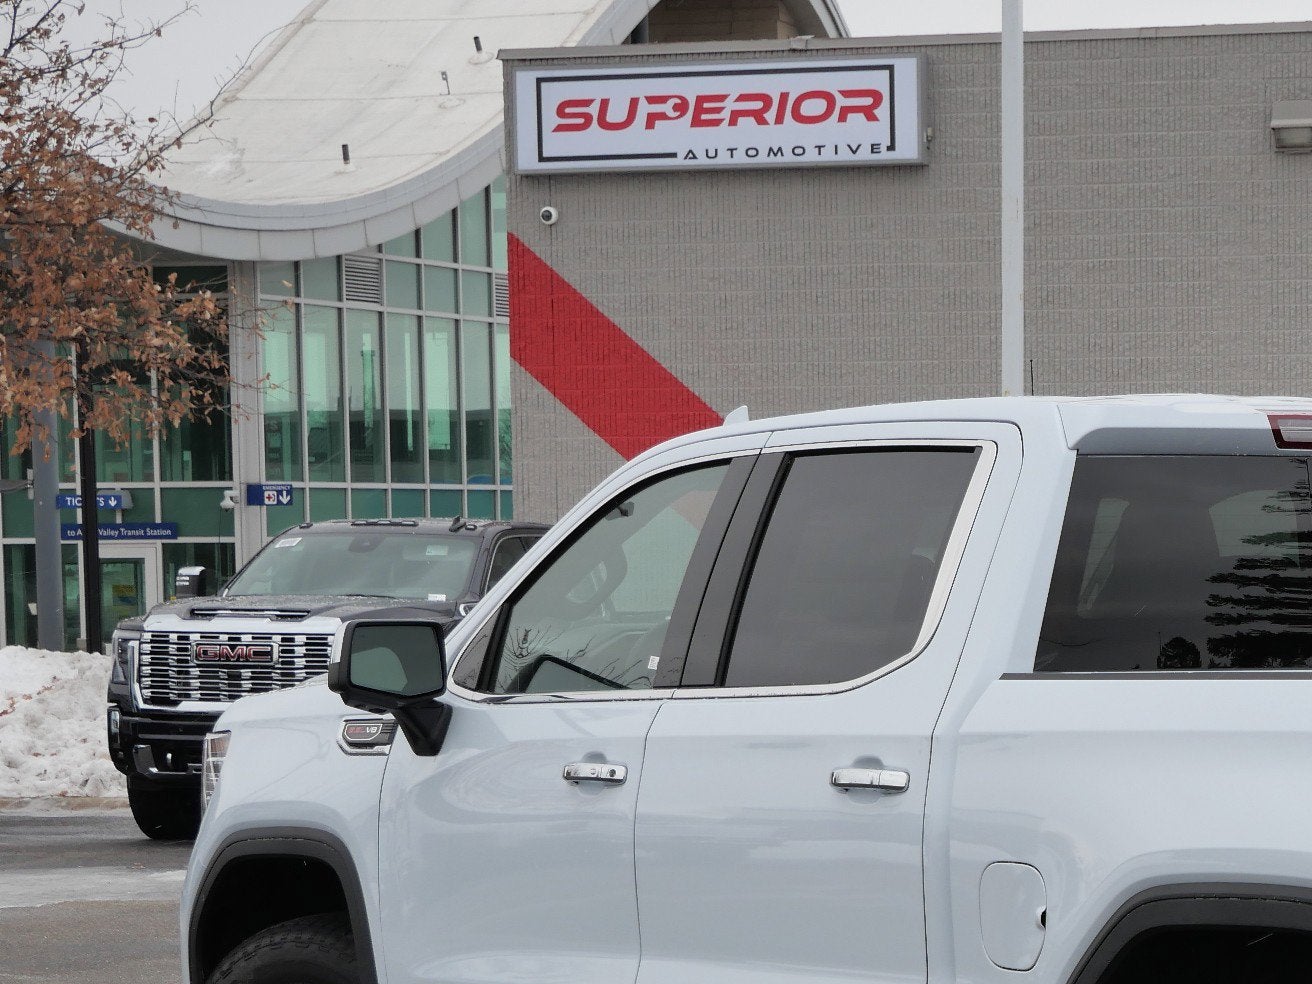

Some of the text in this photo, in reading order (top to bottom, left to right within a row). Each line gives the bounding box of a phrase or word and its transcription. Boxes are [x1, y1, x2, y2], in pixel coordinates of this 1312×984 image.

[551, 88, 884, 133] SUPERIOR
[683, 142, 883, 161] AUTOMOTIVE
[65, 496, 105, 507] TICS
[67, 529, 75, 537] to
[98, 528, 119, 538] Valley
[120, 528, 144, 536] Transit
[146, 527, 172, 536] Station
[196, 644, 272, 661] GMC
